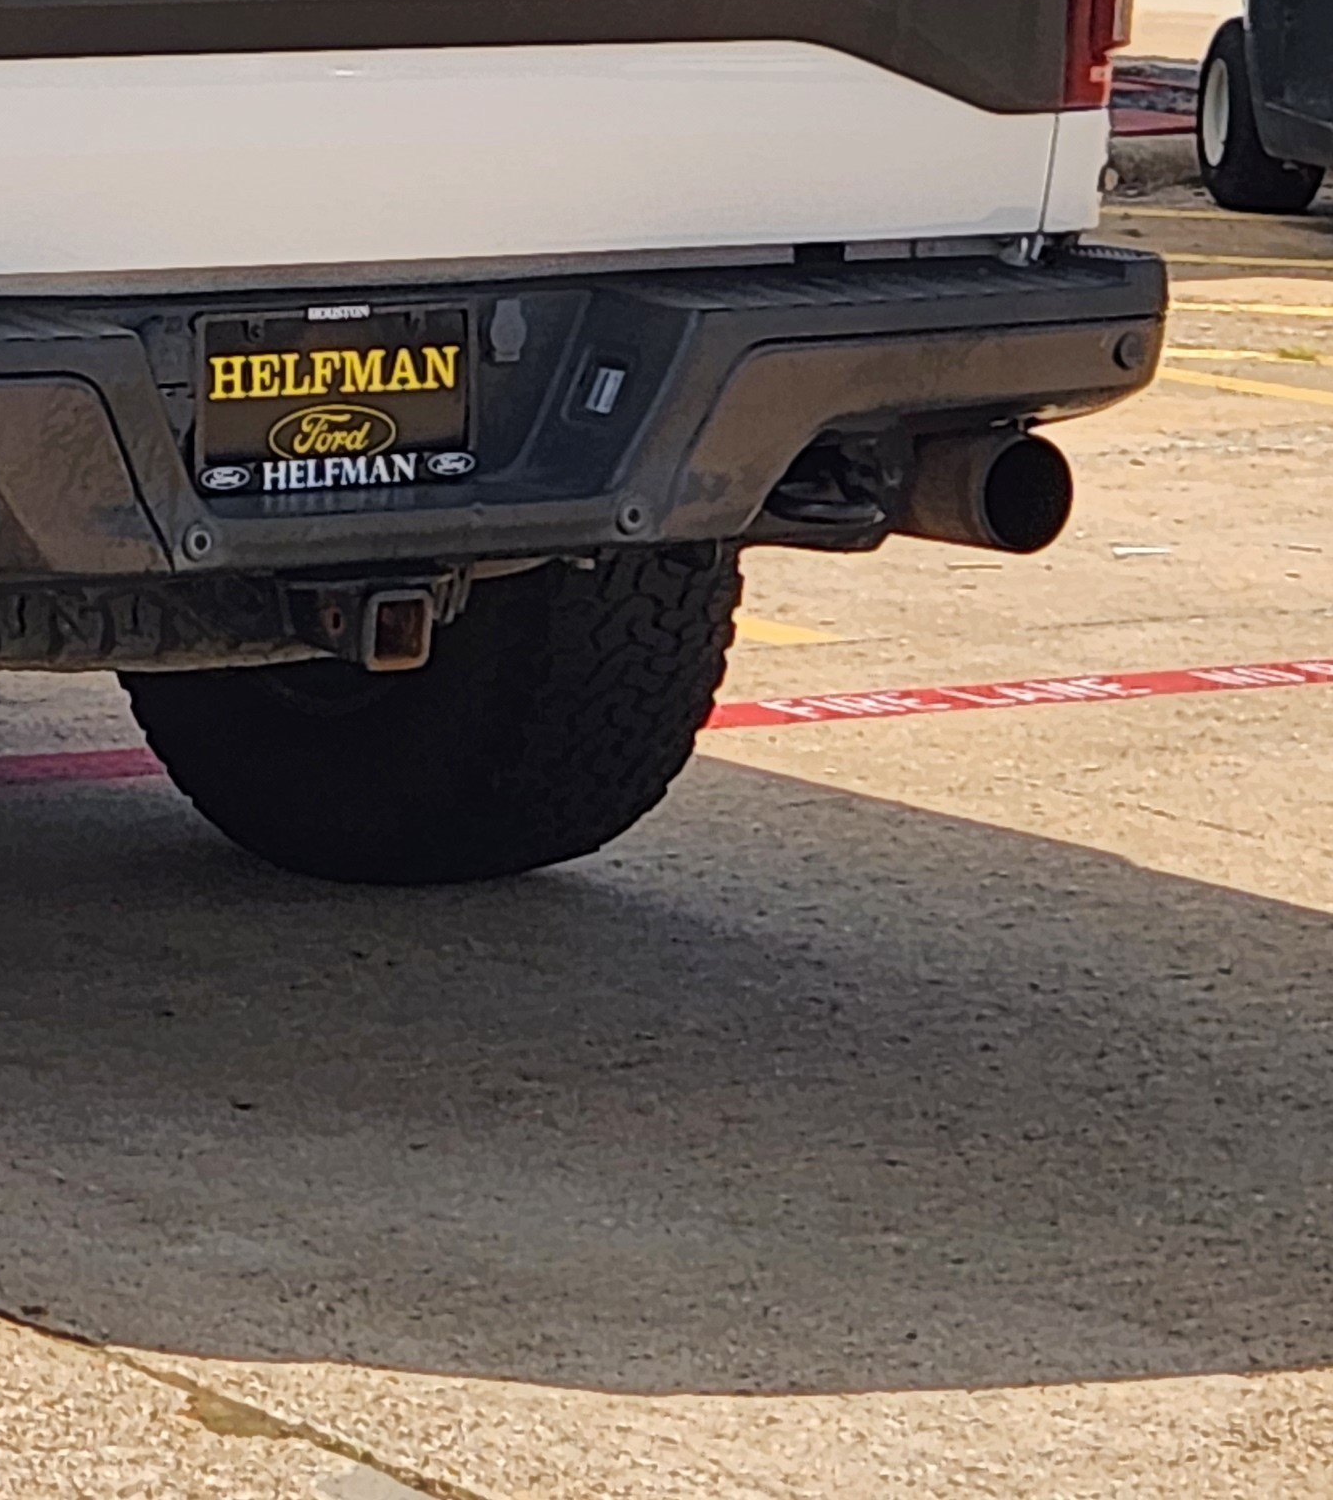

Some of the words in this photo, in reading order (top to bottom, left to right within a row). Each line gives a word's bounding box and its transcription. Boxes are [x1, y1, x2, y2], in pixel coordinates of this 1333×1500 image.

[208, 345, 460, 400] HELFMAN
[293, 413, 372, 453] Ford
[261, 453, 419, 491] HELFMAN
[757, 690, 951, 720] FIRE
